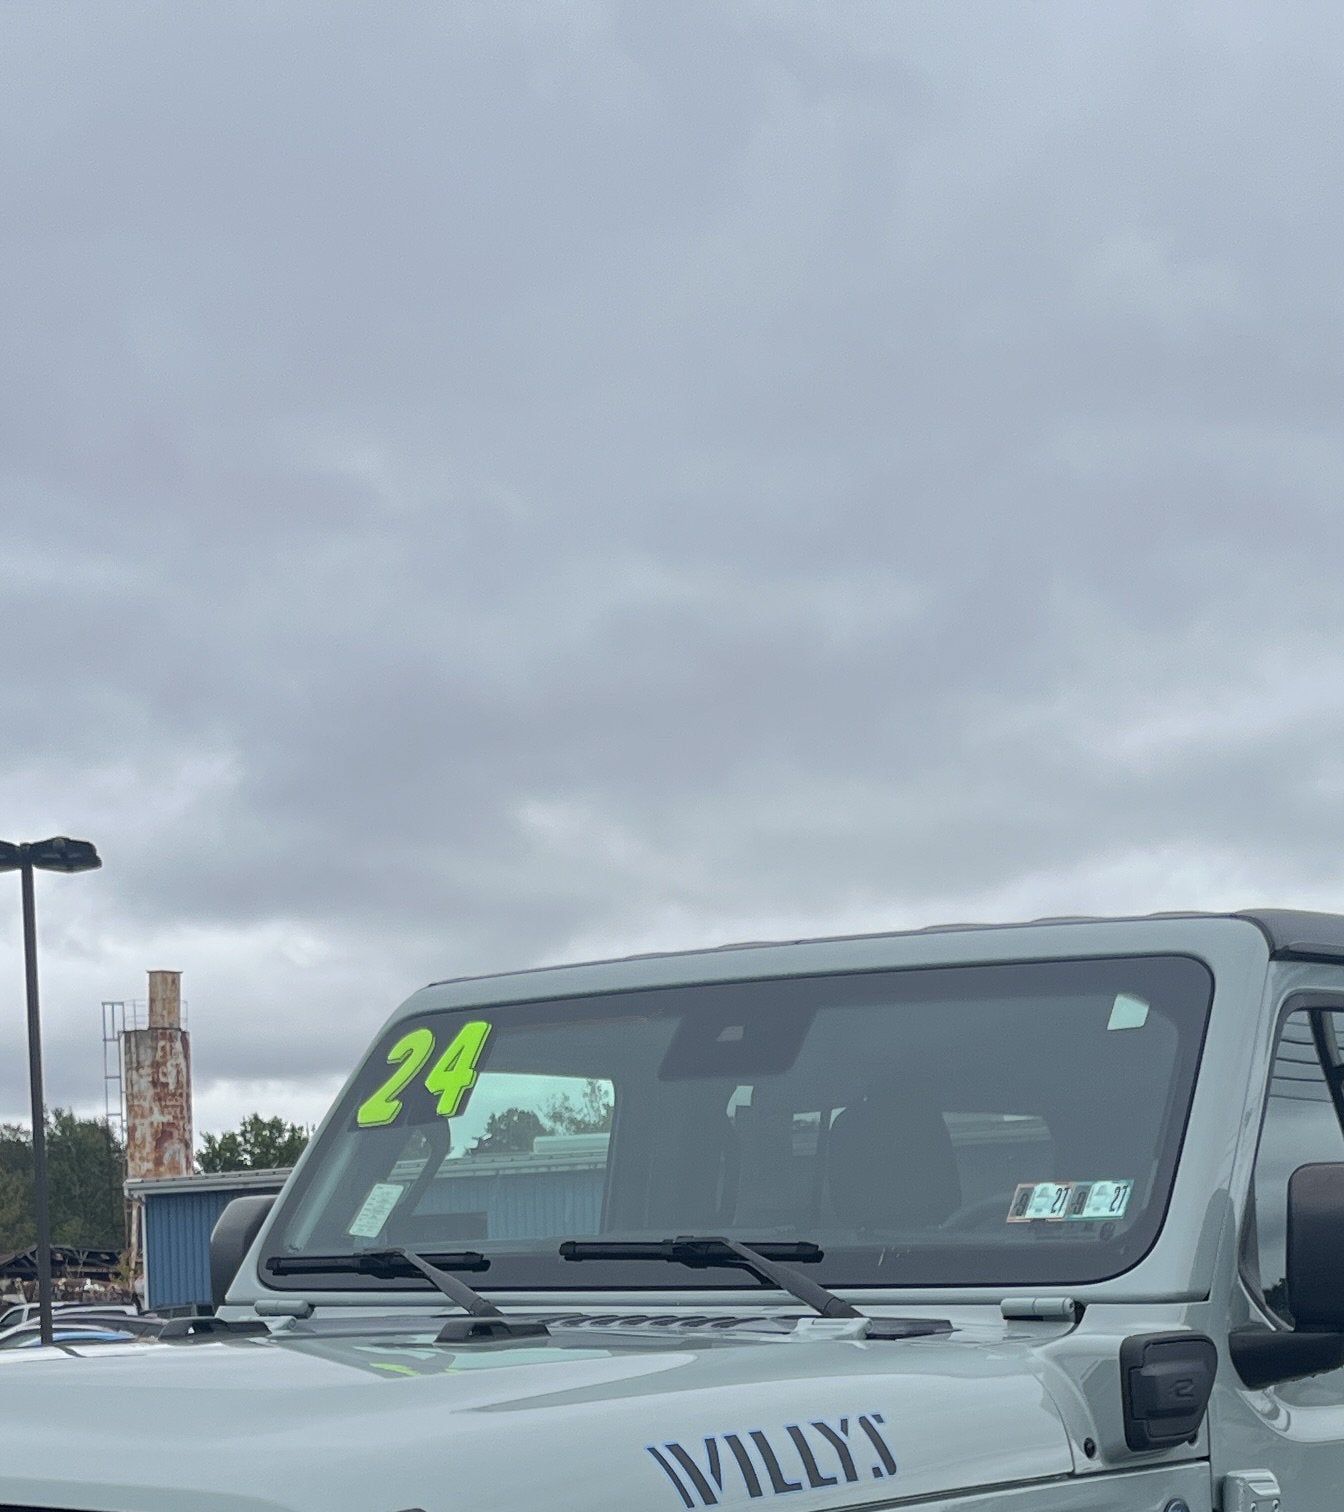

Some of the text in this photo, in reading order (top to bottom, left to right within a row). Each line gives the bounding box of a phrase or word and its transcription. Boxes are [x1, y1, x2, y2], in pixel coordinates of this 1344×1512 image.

[357, 1020, 492, 1128] 24
[1050, 1187, 1071, 1214] 27
[1109, 1185, 1129, 1212] 27
[646, 1412, 897, 1509] WILLYS
